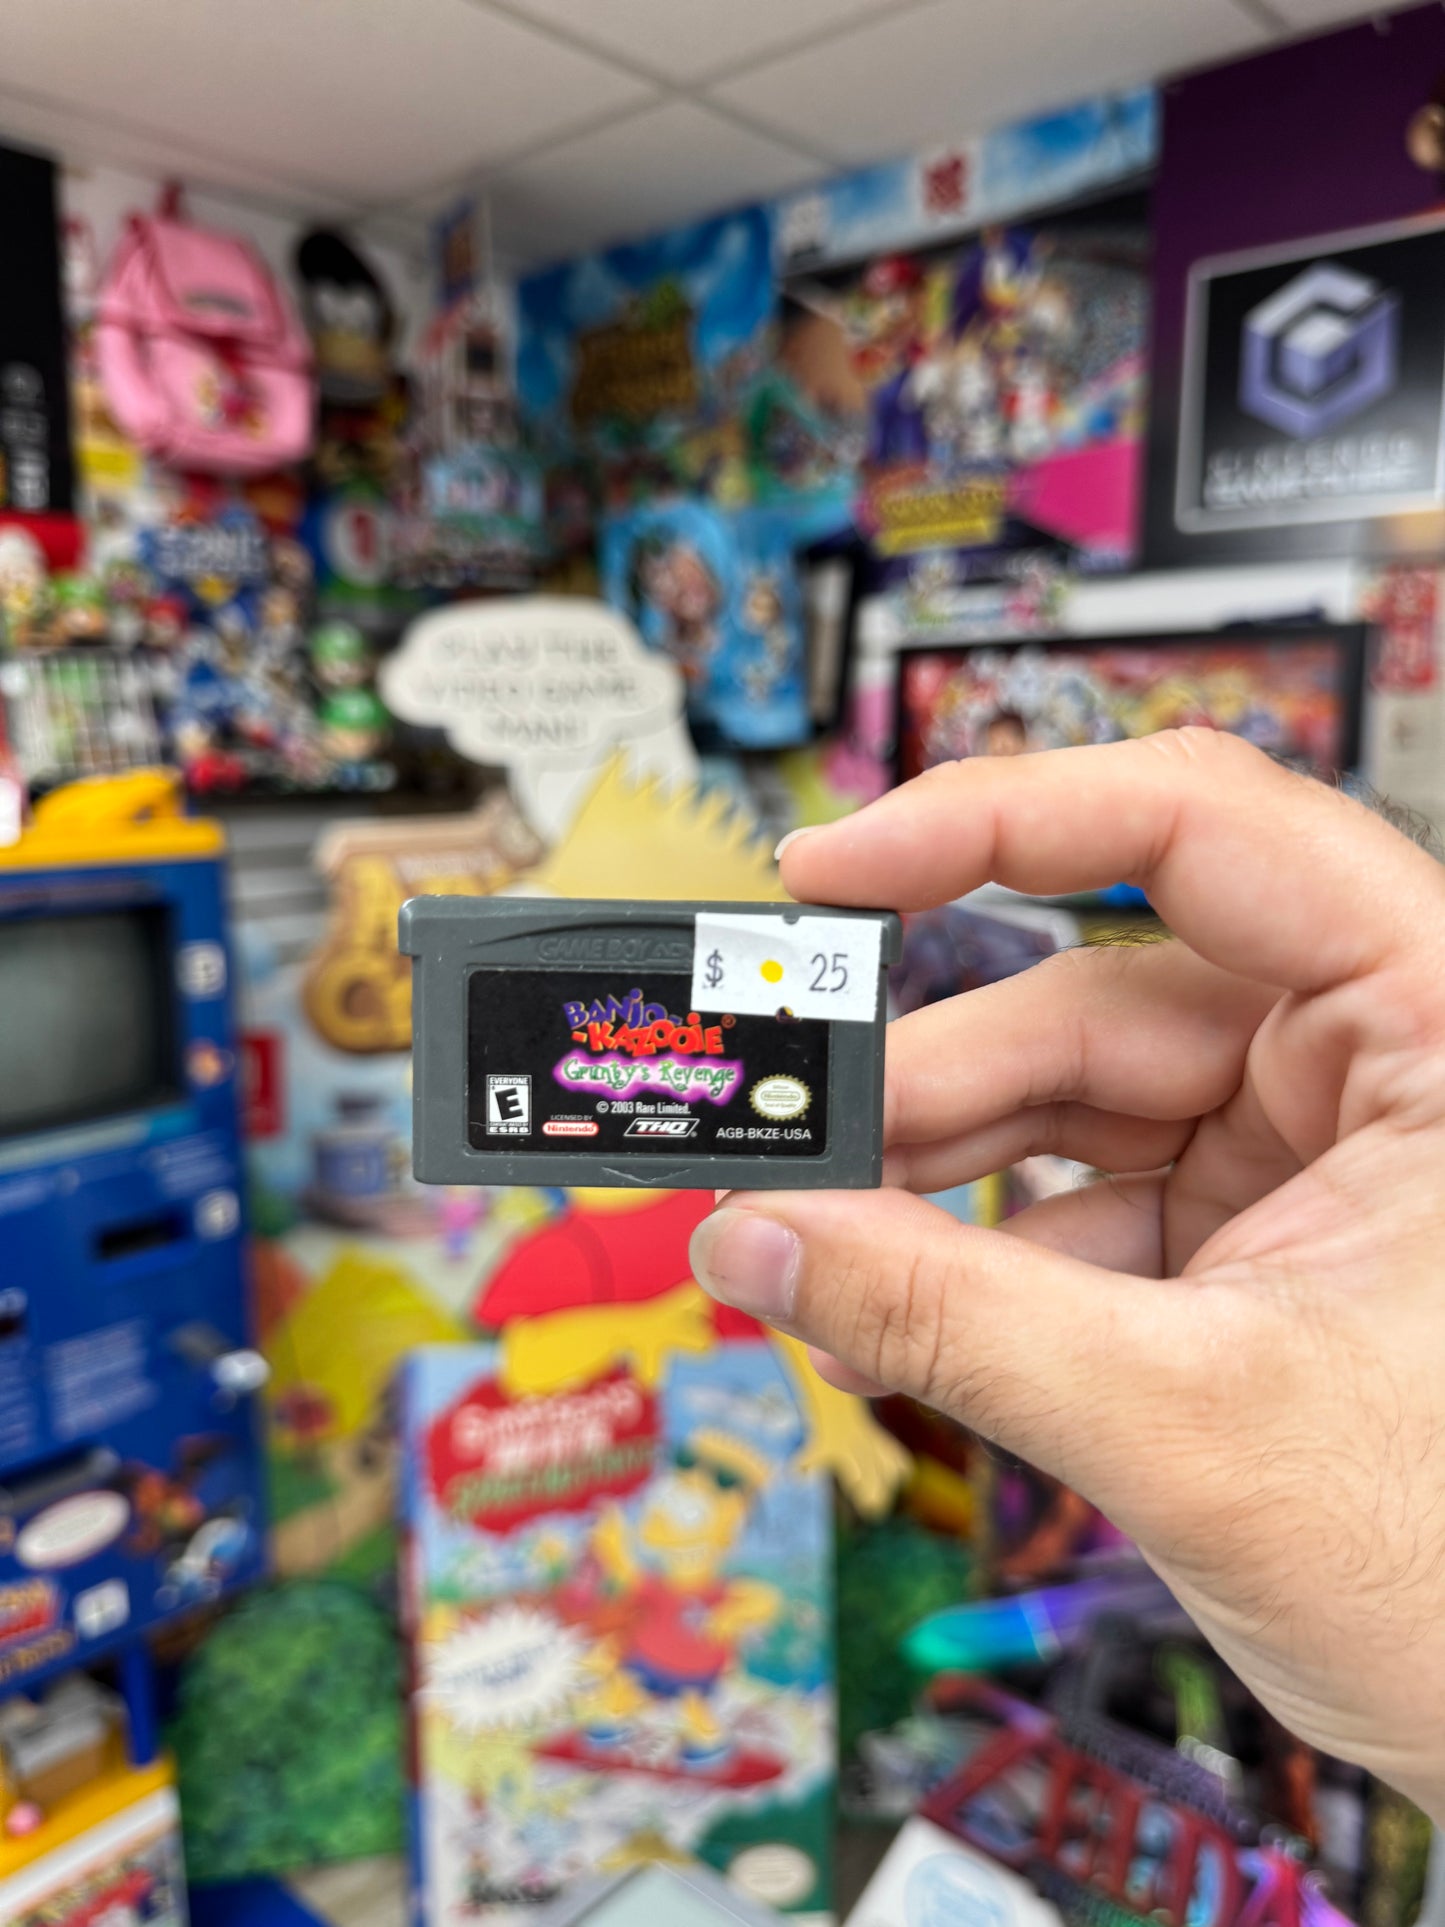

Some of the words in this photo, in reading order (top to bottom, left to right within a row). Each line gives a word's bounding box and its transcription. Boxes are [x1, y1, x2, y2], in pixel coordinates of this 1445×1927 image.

[539, 937, 605, 958] GAME
[606, 937, 653, 959] BOY
[704, 949, 725, 989] $
[809, 953, 849, 992] 25
[489, 1076, 528, 1085] EVERYONE
[562, 1058, 650, 1091] Grunty's
[660, 1060, 736, 1099] Revenge
[494, 1087, 524, 1120] E
[611, 1101, 634, 1114] 2003
[636, 1101, 656, 1114] Rare
[547, 1124, 595, 1133] Nintendo
[635, 1121, 690, 1134] THQ
[715, 1127, 812, 1140] AGB-BKZE-USA
